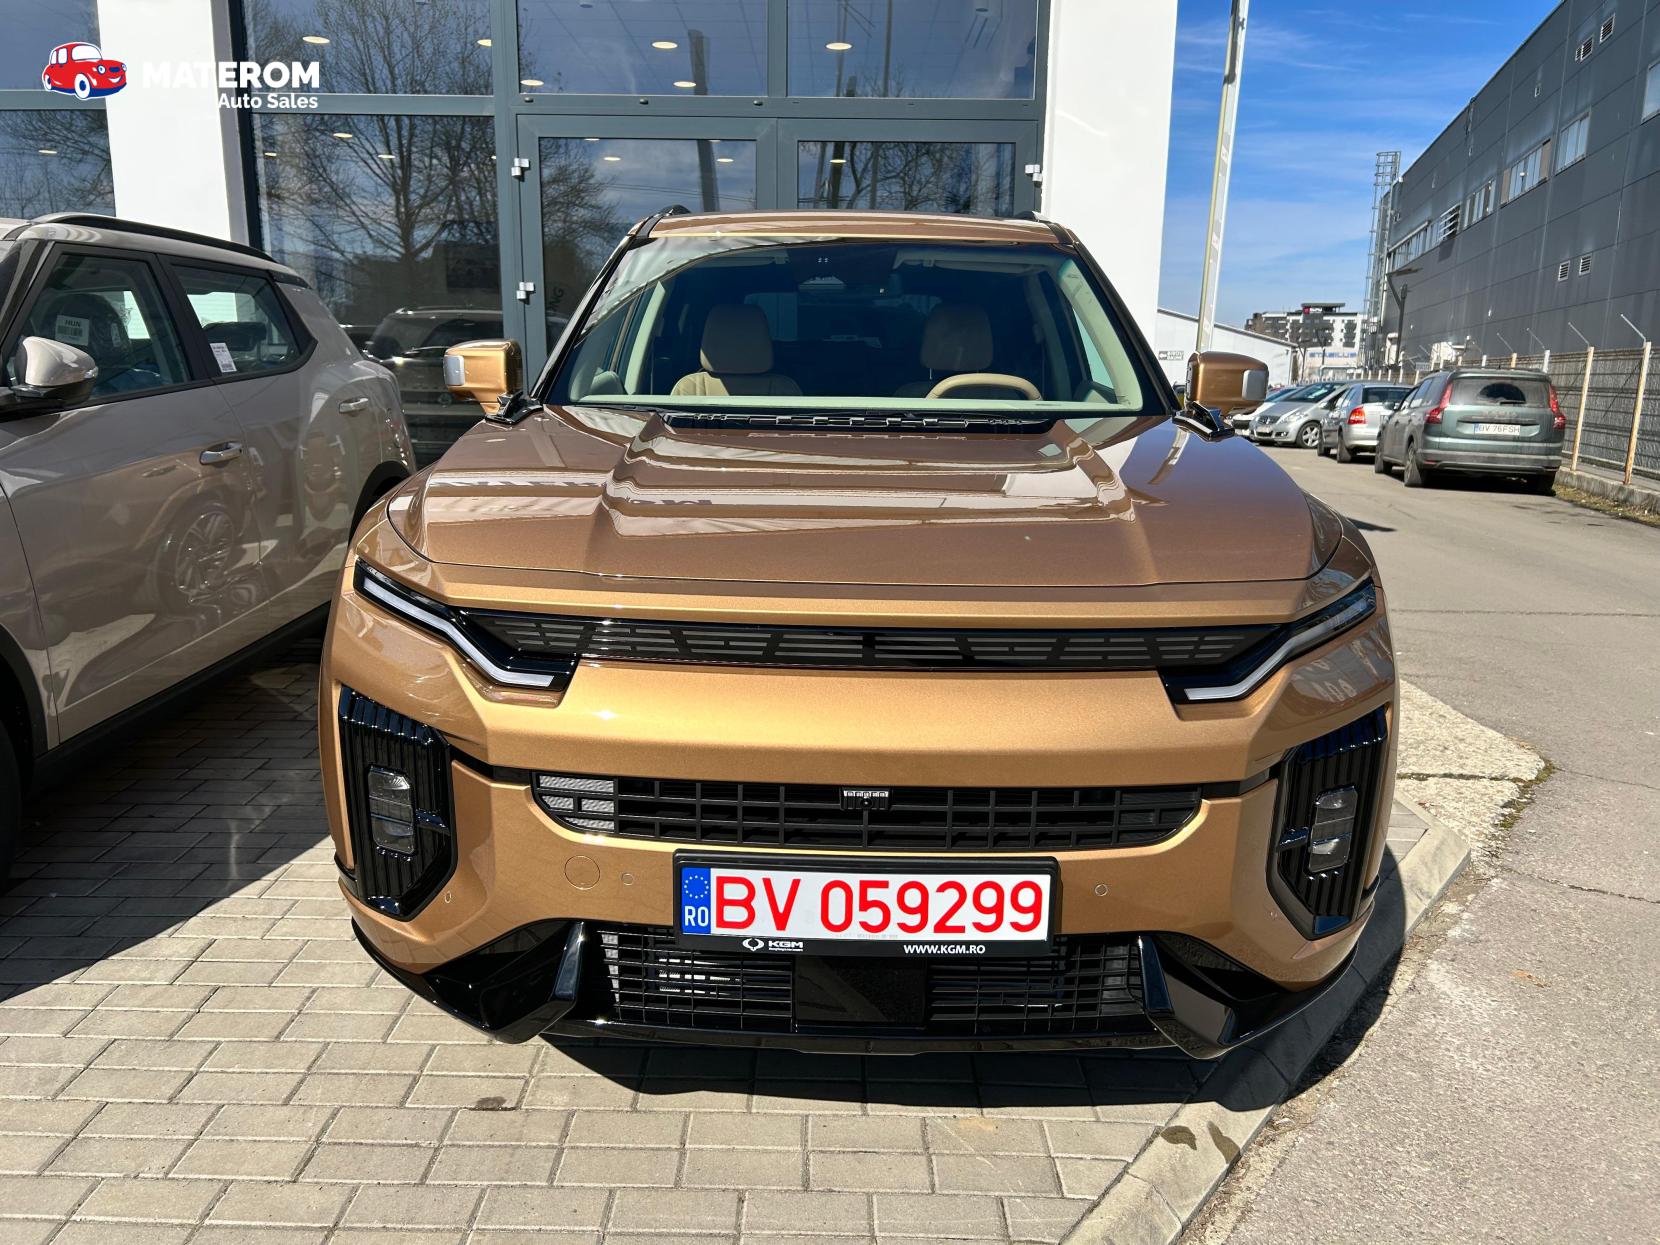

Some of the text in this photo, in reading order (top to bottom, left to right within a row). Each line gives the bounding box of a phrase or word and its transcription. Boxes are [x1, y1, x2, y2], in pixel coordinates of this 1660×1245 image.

[715, 875, 1043, 934] BV 059299
[684, 905, 709, 927] RO
[768, 940, 804, 948] KGM
[903, 944, 986, 954] WWW.KGM.RO
